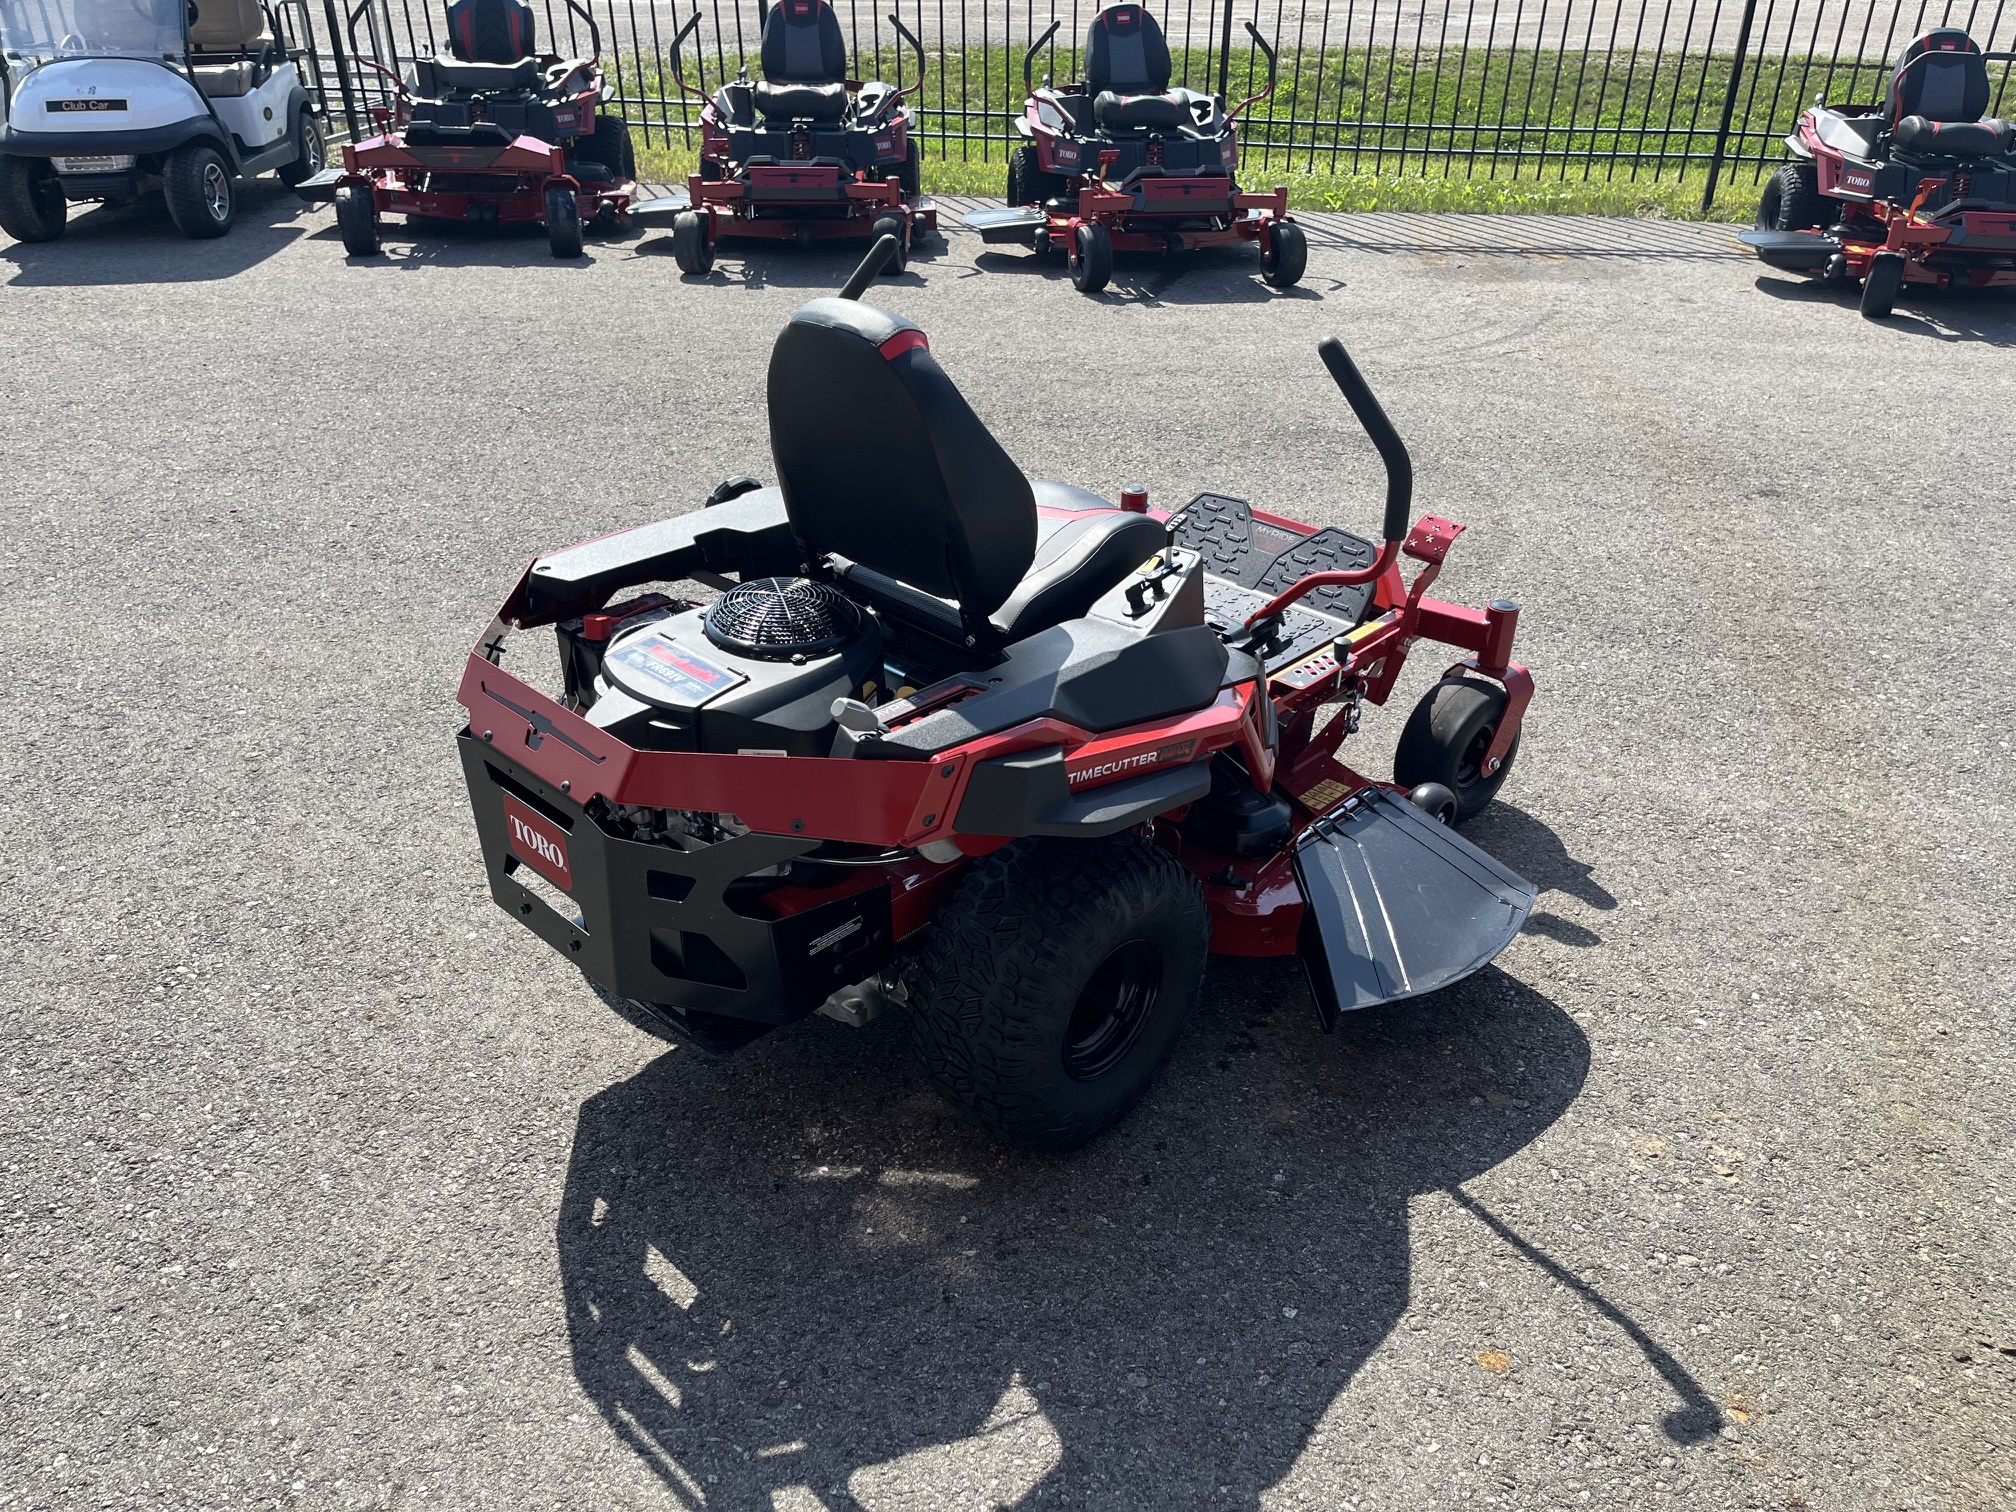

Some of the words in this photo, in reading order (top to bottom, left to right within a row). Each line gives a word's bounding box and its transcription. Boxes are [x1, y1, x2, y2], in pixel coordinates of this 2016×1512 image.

[62, 101, 86, 111] Club
[89, 101, 109, 110] Car
[1059, 149, 1077, 159] TORO
[1847, 175, 1870, 187] TORO
[644, 662, 687, 682] FR691V
[1068, 751, 1158, 784] TIMECUTTER
